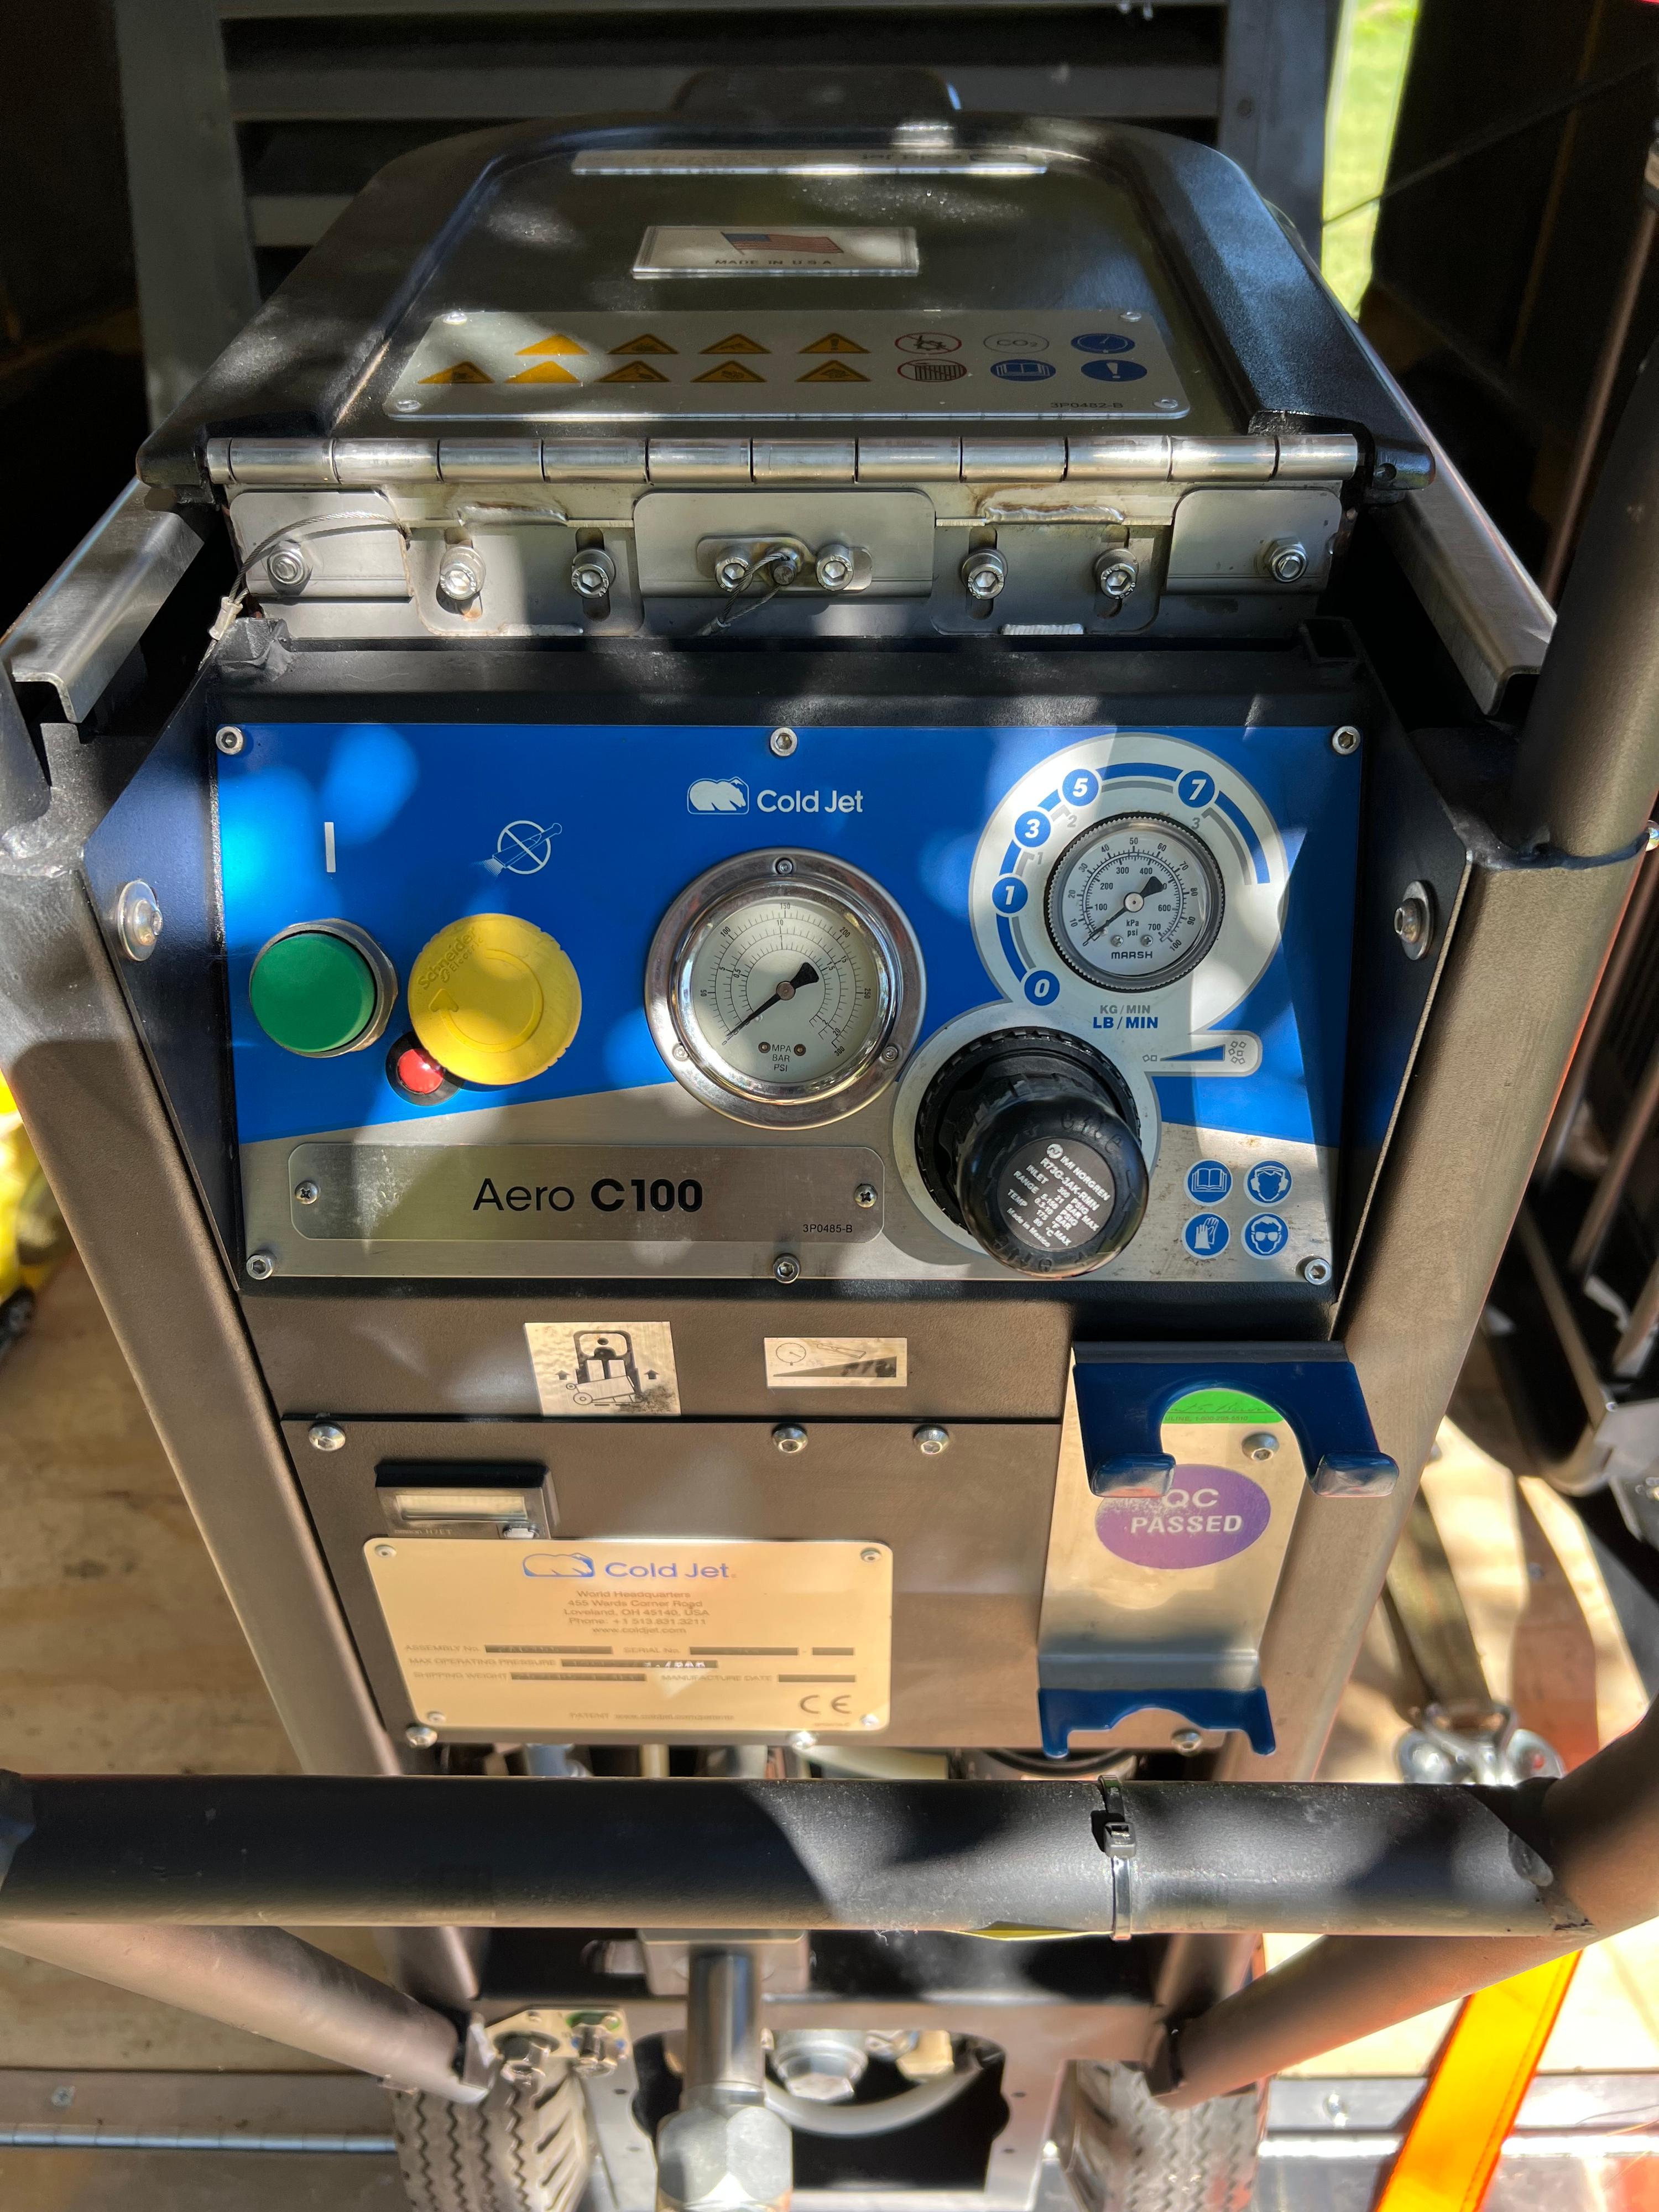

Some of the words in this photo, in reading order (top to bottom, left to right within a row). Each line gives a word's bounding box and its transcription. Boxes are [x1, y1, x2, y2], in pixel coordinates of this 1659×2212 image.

[1072, 778, 1088, 797] 5
[1189, 779, 1207, 800] 7
[757, 790, 820, 813] Cold
[824, 790, 864, 813] Jet
[1067, 815, 1077, 828] 2
[1191, 817, 1201, 830] 3
[1024, 818, 1040, 838] 3
[1101, 844, 1110, 853] 40
[1157, 843, 1167, 852] 60
[1078, 863, 1088, 873] 30
[1180, 860, 1189, 871] 70
[1005, 885, 1015, 905] 1
[1068, 889, 1076, 899] 20
[1190, 888, 1198, 896] 80
[1070, 918, 1078, 927] 10
[1187, 916, 1196, 926] 90
[720, 926, 732, 937] 100
[839, 926, 851, 938] 200
[1127, 929, 1138, 937] psi
[1169, 940, 1182, 951] 100
[418, 926, 476, 990] Schneider
[841, 955, 848, 964] 15
[1111, 951, 1152, 959] MARSH
[1034, 979, 1050, 998] 0
[832, 1027, 841, 1037] 20
[771, 1044, 791, 1052] MPA
[834, 1045, 846, 1057] 300
[772, 1054, 790, 1062] BAR
[774, 1063, 788, 1072] PSI
[1060, 1155, 1076, 1170] IMI
[1072, 1167, 1111, 1201] NORGREN
[472, 1178, 575, 1212] Aero
[591, 1178, 703, 1212] C100
[1026, 1165, 1050, 1185] INLET
[1070, 1197, 1089, 1215] PSIG
[1007, 1188, 1028, 1207] TEMP
[1036, 1209, 1049, 1221] 175
[1013, 1170, 1040, 1194] RANGE
[1060, 1209, 1078, 1227] PSIG
[1054, 1194, 1065, 1204] 21
[1065, 1203, 1083, 1219] BAR
[1081, 1215, 1100, 1232] MAX
[802, 1223, 853, 1233] 3P0485-B
[1006, 1207, 1024, 1224] Made
[1029, 1227, 1051, 1248] Mexico
[1055, 1214, 1072, 1231] BAR
[1053, 1230, 1072, 1246] MAX
[1161, 1488, 1219, 1509] QC
[1130, 1515, 1243, 1533] PASSED
[605, 1562, 678, 1578] Cold
[685, 1563, 730, 1578] Jet
[614, 1591, 691, 1599] Headquarters
